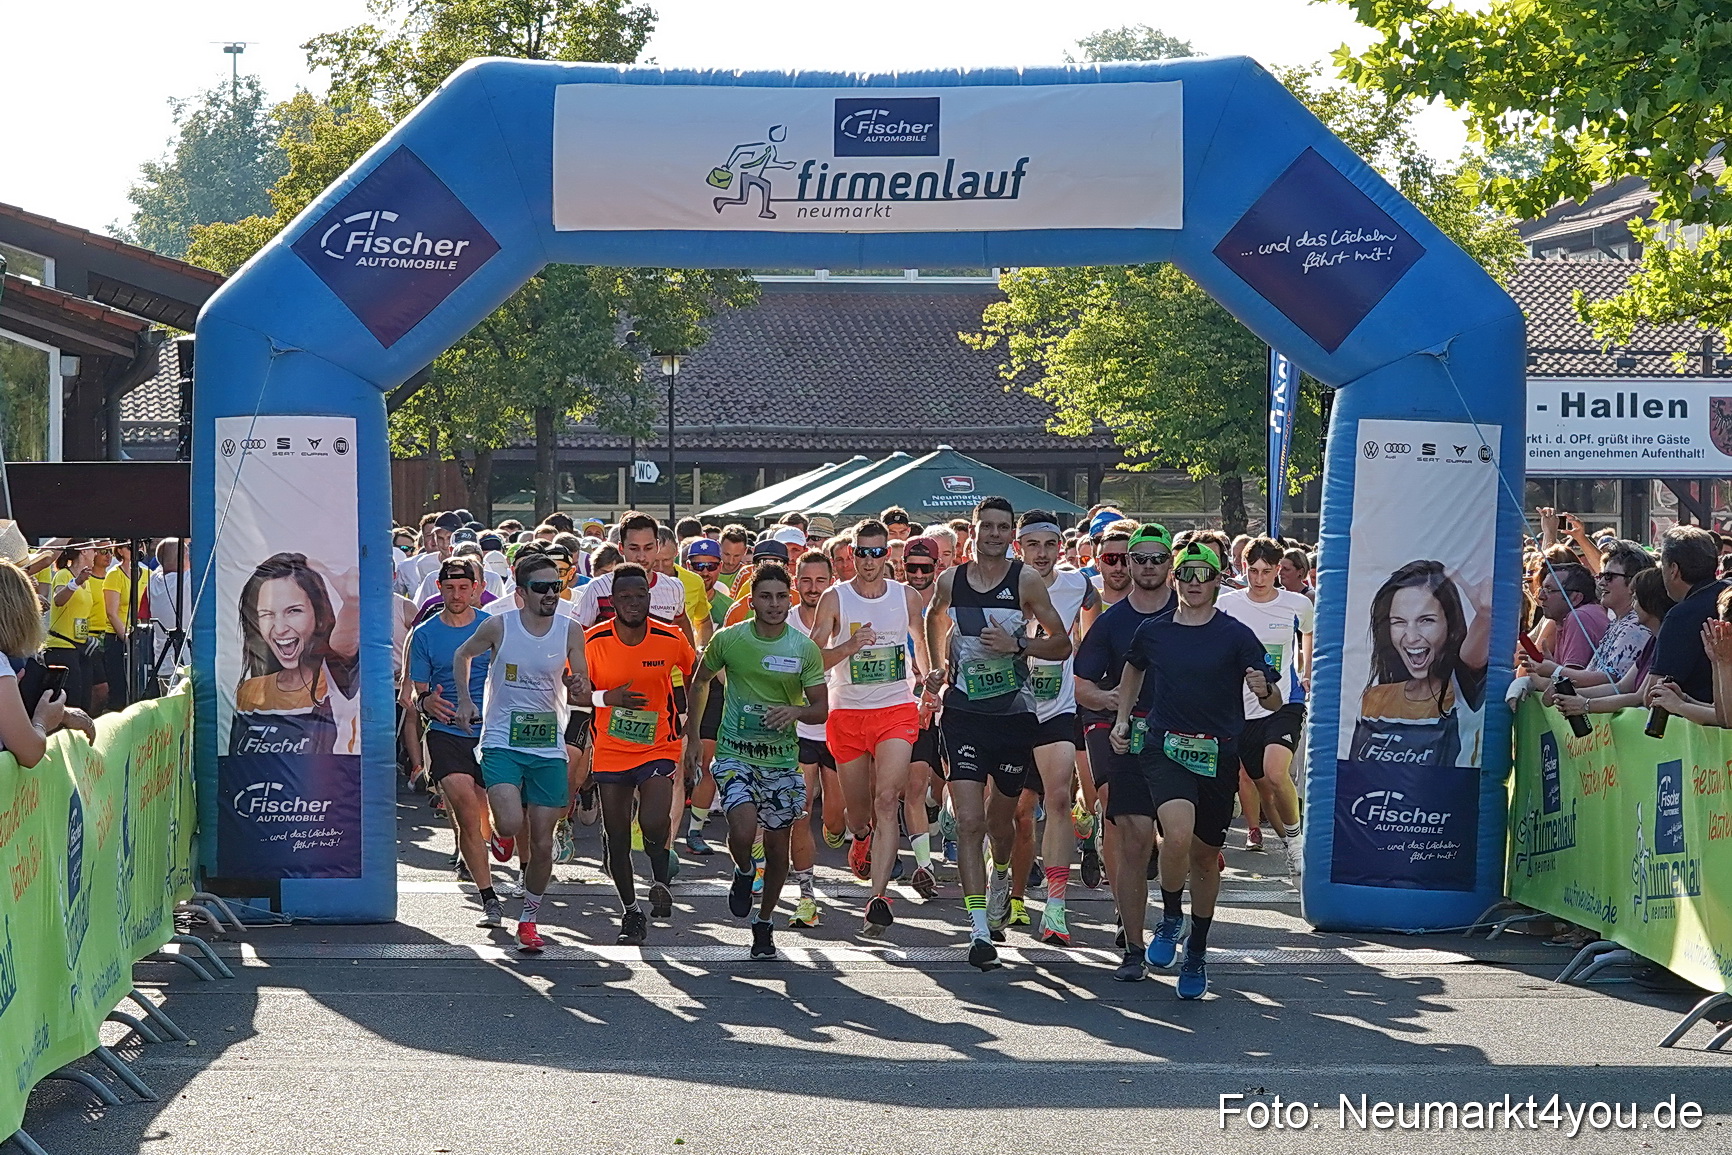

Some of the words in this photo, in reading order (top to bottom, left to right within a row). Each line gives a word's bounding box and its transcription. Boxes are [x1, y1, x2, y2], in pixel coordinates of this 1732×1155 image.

[856, 116, 934, 136] Fischer
[863, 133, 928, 144] AUTOMOBILE
[796, 157, 1030, 201] firmenlauf
[796, 203, 893, 219] neumarkt
[344, 231, 470, 257] Fischer
[1258, 234, 1292, 255] und
[1295, 230, 1327, 249] das
[1330, 227, 1398, 245] Lächeln
[355, 256, 458, 271] AUTOMOBILE
[1302, 251, 1350, 274] fährt
[1354, 246, 1394, 262] mit!
[1560, 391, 1689, 419] Hallen
[1526, 433, 1542, 445] rkt
[1545, 433, 1552, 445] i.
[1555, 433, 1566, 445] d.
[1569, 433, 1595, 445] OPf.
[1597, 433, 1629, 447] grüßt
[1631, 433, 1654, 445] ihre
[1656, 433, 1691, 446] Gäste
[1529, 447, 1561, 459] einen
[1563, 447, 1638, 461] angenehmen
[1641, 447, 1706, 460] Aufenthalt!
[637, 463, 652, 480] WC
[862, 660, 886, 673] 475
[977, 672, 1004, 687] 196
[521, 724, 547, 737] 476
[617, 718, 650, 734] 1377
[244, 736, 310, 755] Fischer
[1173, 748, 1209, 764] 1092
[1365, 745, 1433, 765] Fischer
[250, 797, 332, 813] Fischer
[256, 815, 326, 823] AUTOMOBILE
[1368, 805, 1451, 824] Fischer
[1374, 825, 1444, 834] AUTOMOBILE
[1532, 798, 1577, 852] firmenlauf
[269, 830, 288, 841] und
[289, 828, 307, 839] das
[292, 840, 318, 853] fährt
[320, 837, 341, 848] mit!
[1387, 841, 1406, 851] und
[1407, 841, 1425, 850] das
[1409, 852, 1436, 865] fährt
[1436, 851, 1458, 860] mit!
[1648, 843, 1701, 896] firmenlau
[1651, 899, 1676, 920] neumarkt
